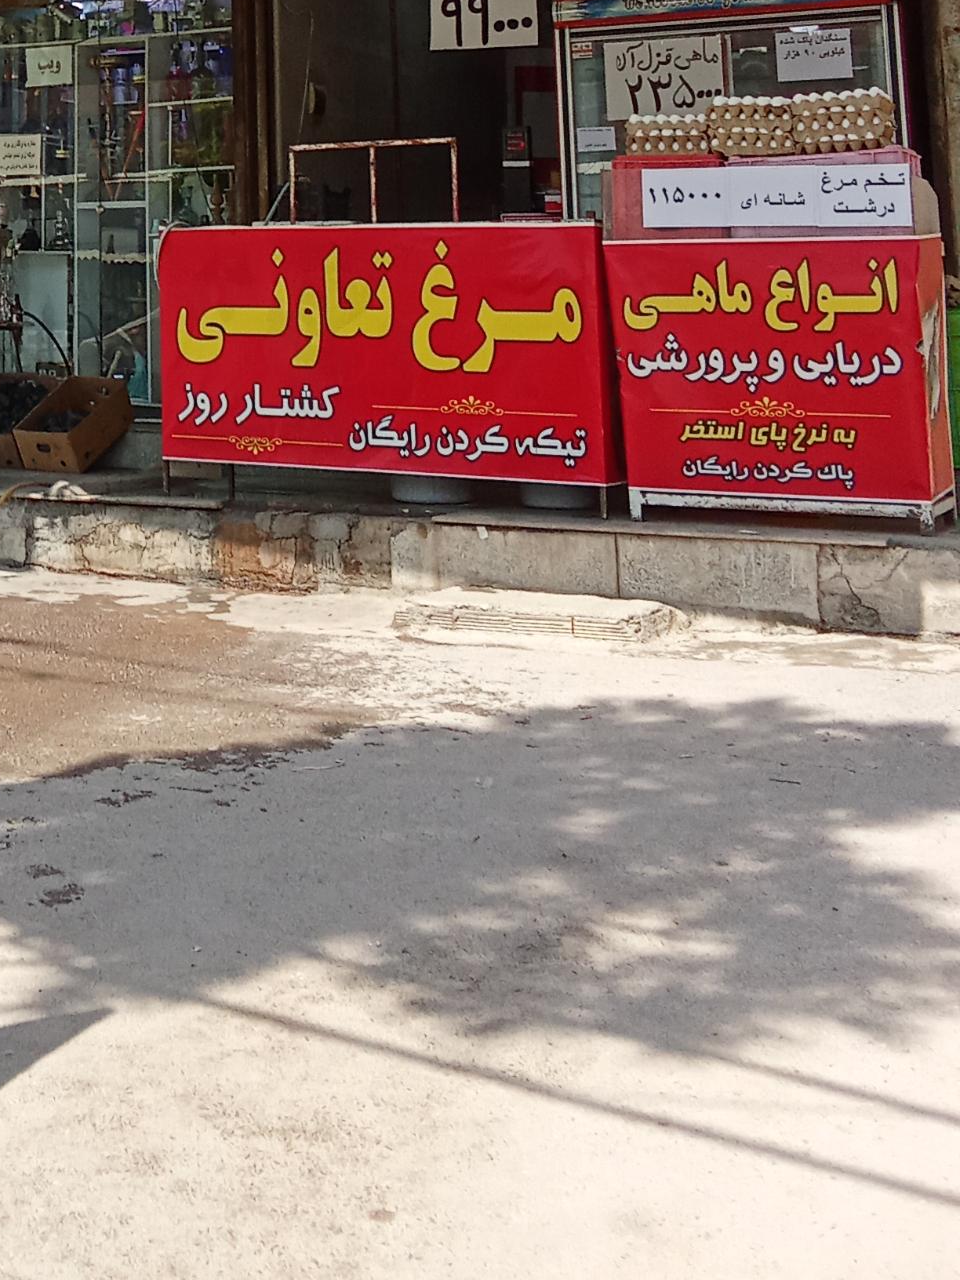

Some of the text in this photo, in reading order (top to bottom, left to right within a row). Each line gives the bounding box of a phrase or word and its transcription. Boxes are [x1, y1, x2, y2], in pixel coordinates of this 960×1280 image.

[616, 38, 719, 74] ماهی قزل آلا
[625, 72, 722, 114] ۲۳۵۰۰۰
[649, 186, 721, 205] ۱۱۵۰۰۰
[764, 191, 806, 208] شانه
[820, 171, 905, 194] تخم مرغ
[833, 199, 895, 218] درشت
[176, 239, 583, 373] مرغ تعاونی
[623, 257, 898, 332] انواع ماهی
[627, 332, 759, 393] پرورشی
[793, 340, 903, 386] دریایی
[178, 383, 340, 425] کشتار روز
[348, 415, 587, 468] تیکه کردن رایگان
[679, 419, 857, 452] به نرخ پای استخر
[682, 456, 749, 481] رایگان
[753, 461, 813, 483] کردن
